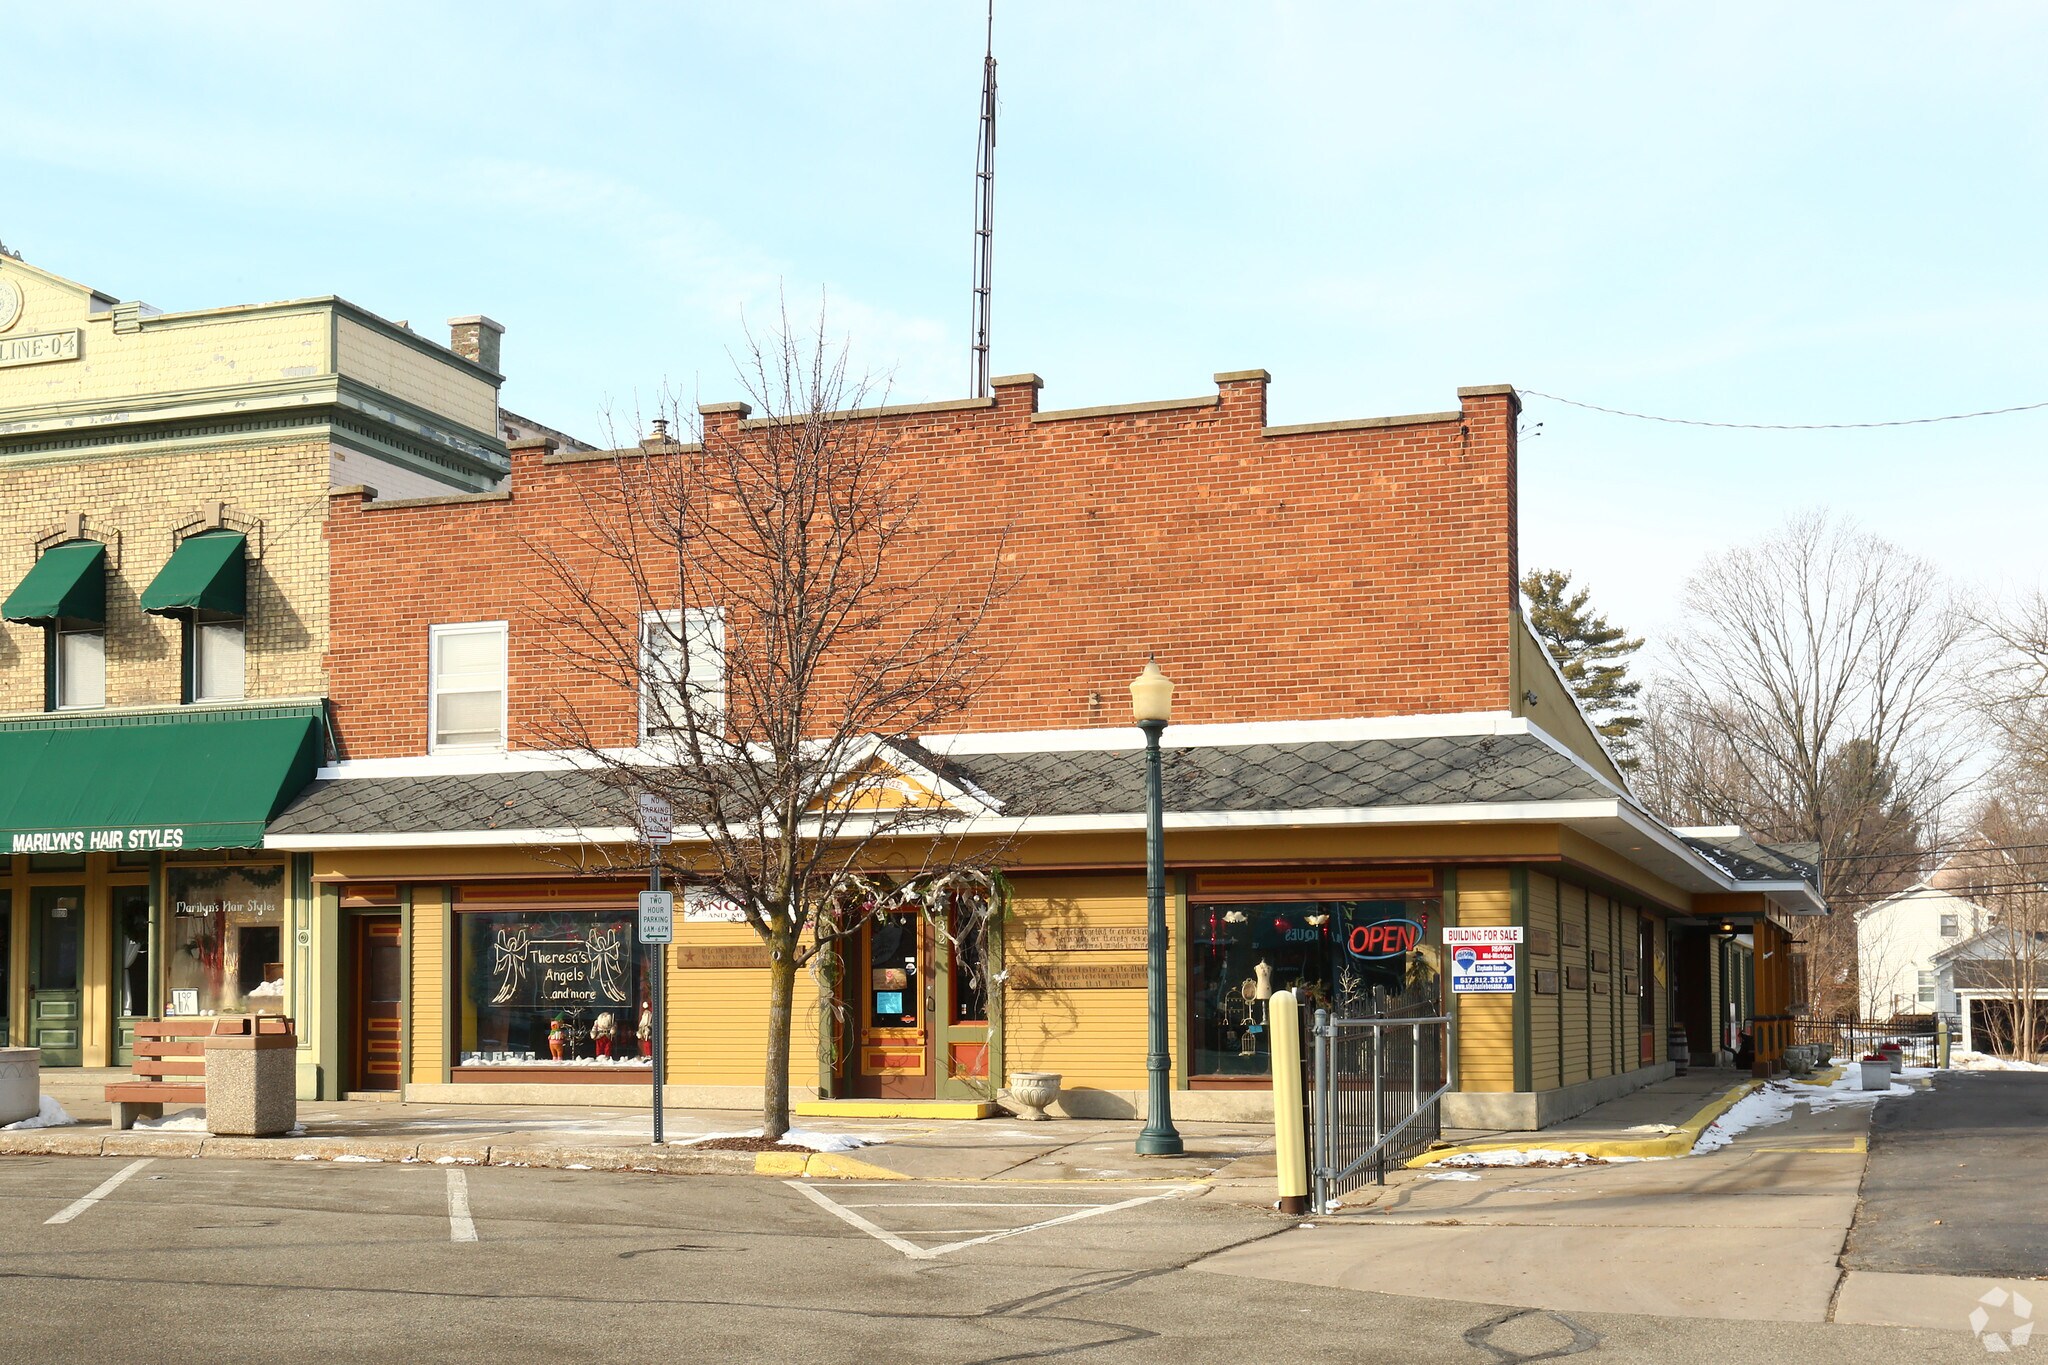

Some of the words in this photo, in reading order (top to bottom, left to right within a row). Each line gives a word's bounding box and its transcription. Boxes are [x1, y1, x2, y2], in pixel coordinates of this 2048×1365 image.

[12, 831, 84, 852] MARILYN'S
[90, 830, 124, 849] HAIR
[128, 828, 184, 849] STYLES
[176, 901, 219, 917] Marilyn's
[222, 901, 244, 912] Hair
[247, 899, 276, 916] Styles
[1350, 926, 1417, 953] OPEN
[1448, 930, 1482, 941] BUILDING
[1483, 930, 1498, 941] FOR
[1499, 930, 1518, 941] SALE
[529, 950, 587, 964] Theresa's
[545, 967, 584, 985] Angels
[570, 991, 597, 999] more
